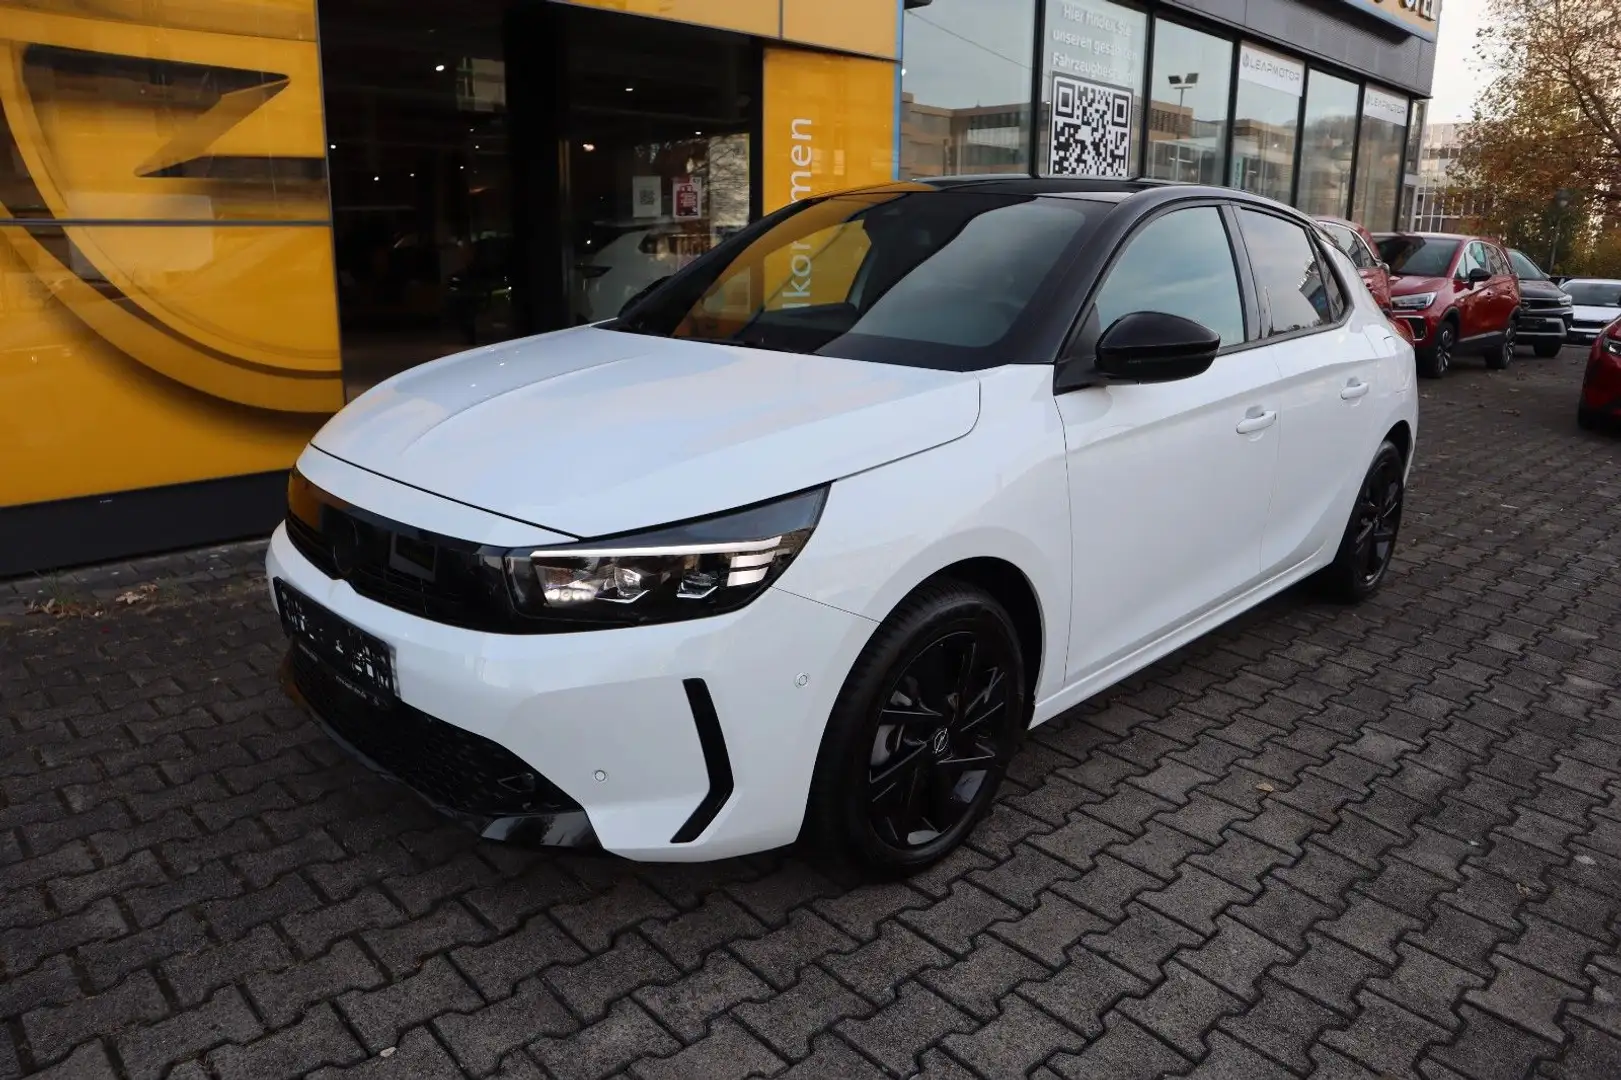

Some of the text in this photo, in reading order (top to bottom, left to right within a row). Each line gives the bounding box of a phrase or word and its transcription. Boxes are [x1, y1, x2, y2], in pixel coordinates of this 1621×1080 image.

[1063, 4, 1083, 24] Hier
[1053, 29, 1092, 52] unseren
[1249, 58, 1301, 82] LEAPMOTOR
